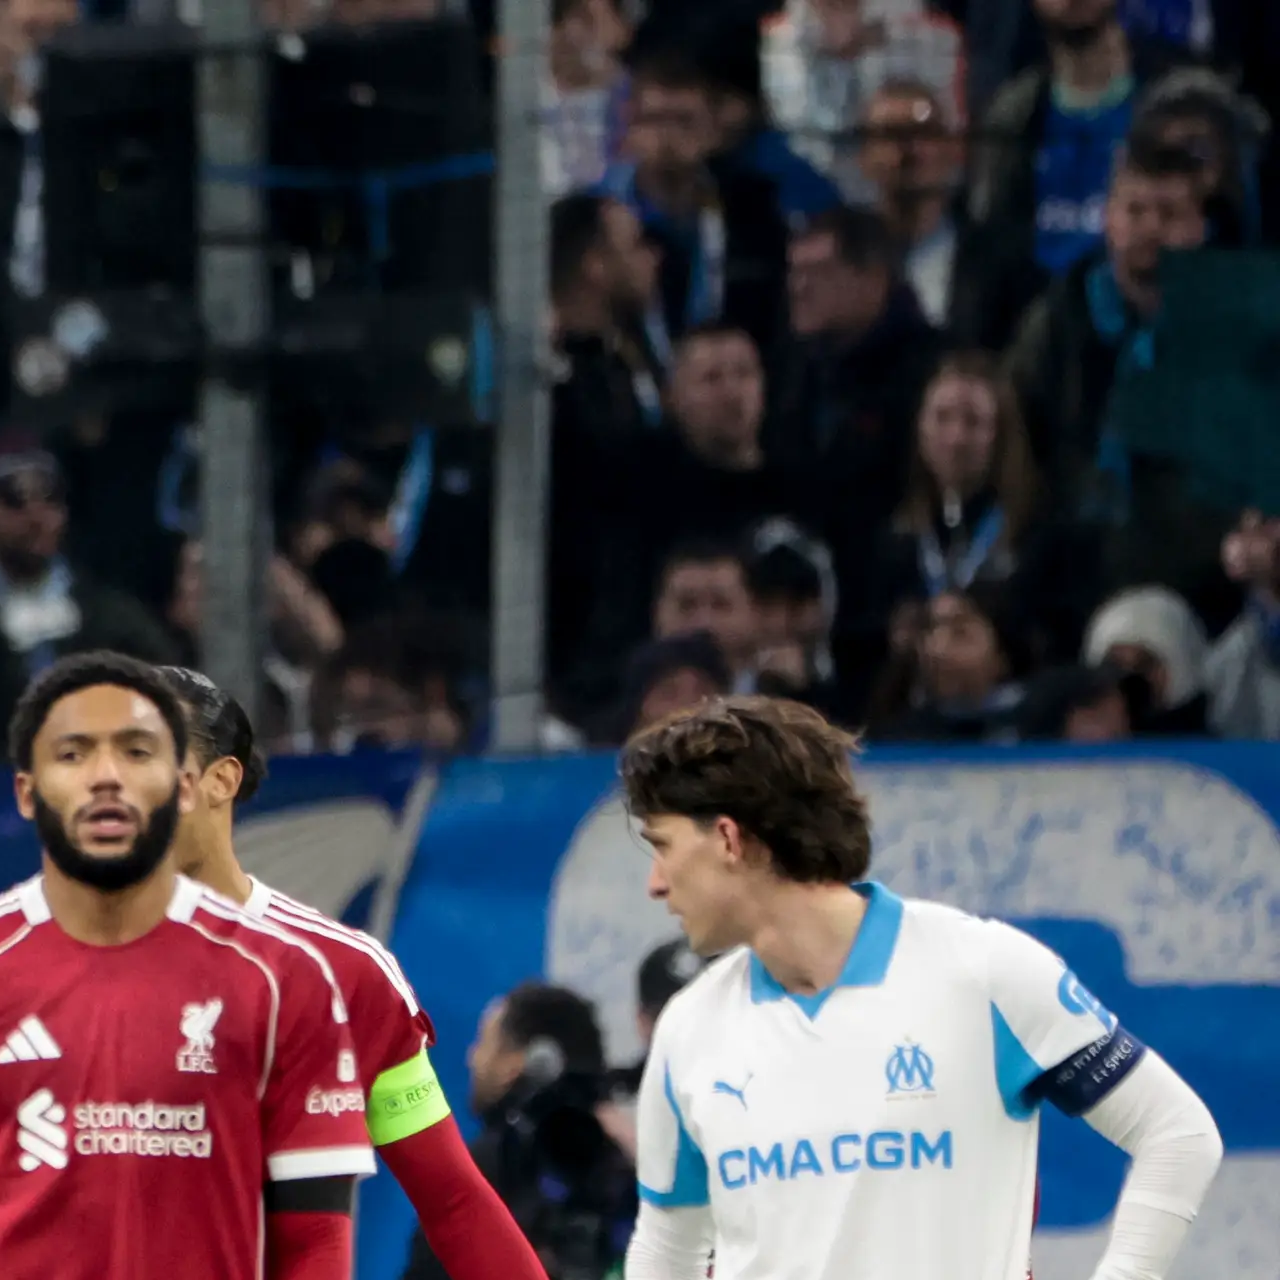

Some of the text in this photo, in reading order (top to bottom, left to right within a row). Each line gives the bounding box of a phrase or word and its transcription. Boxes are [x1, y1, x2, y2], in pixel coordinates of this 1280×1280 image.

[74, 1102, 206, 1132] standard
[75, 1130, 212, 1159] chartered
[717, 1130, 953, 1190] CMA CGM
